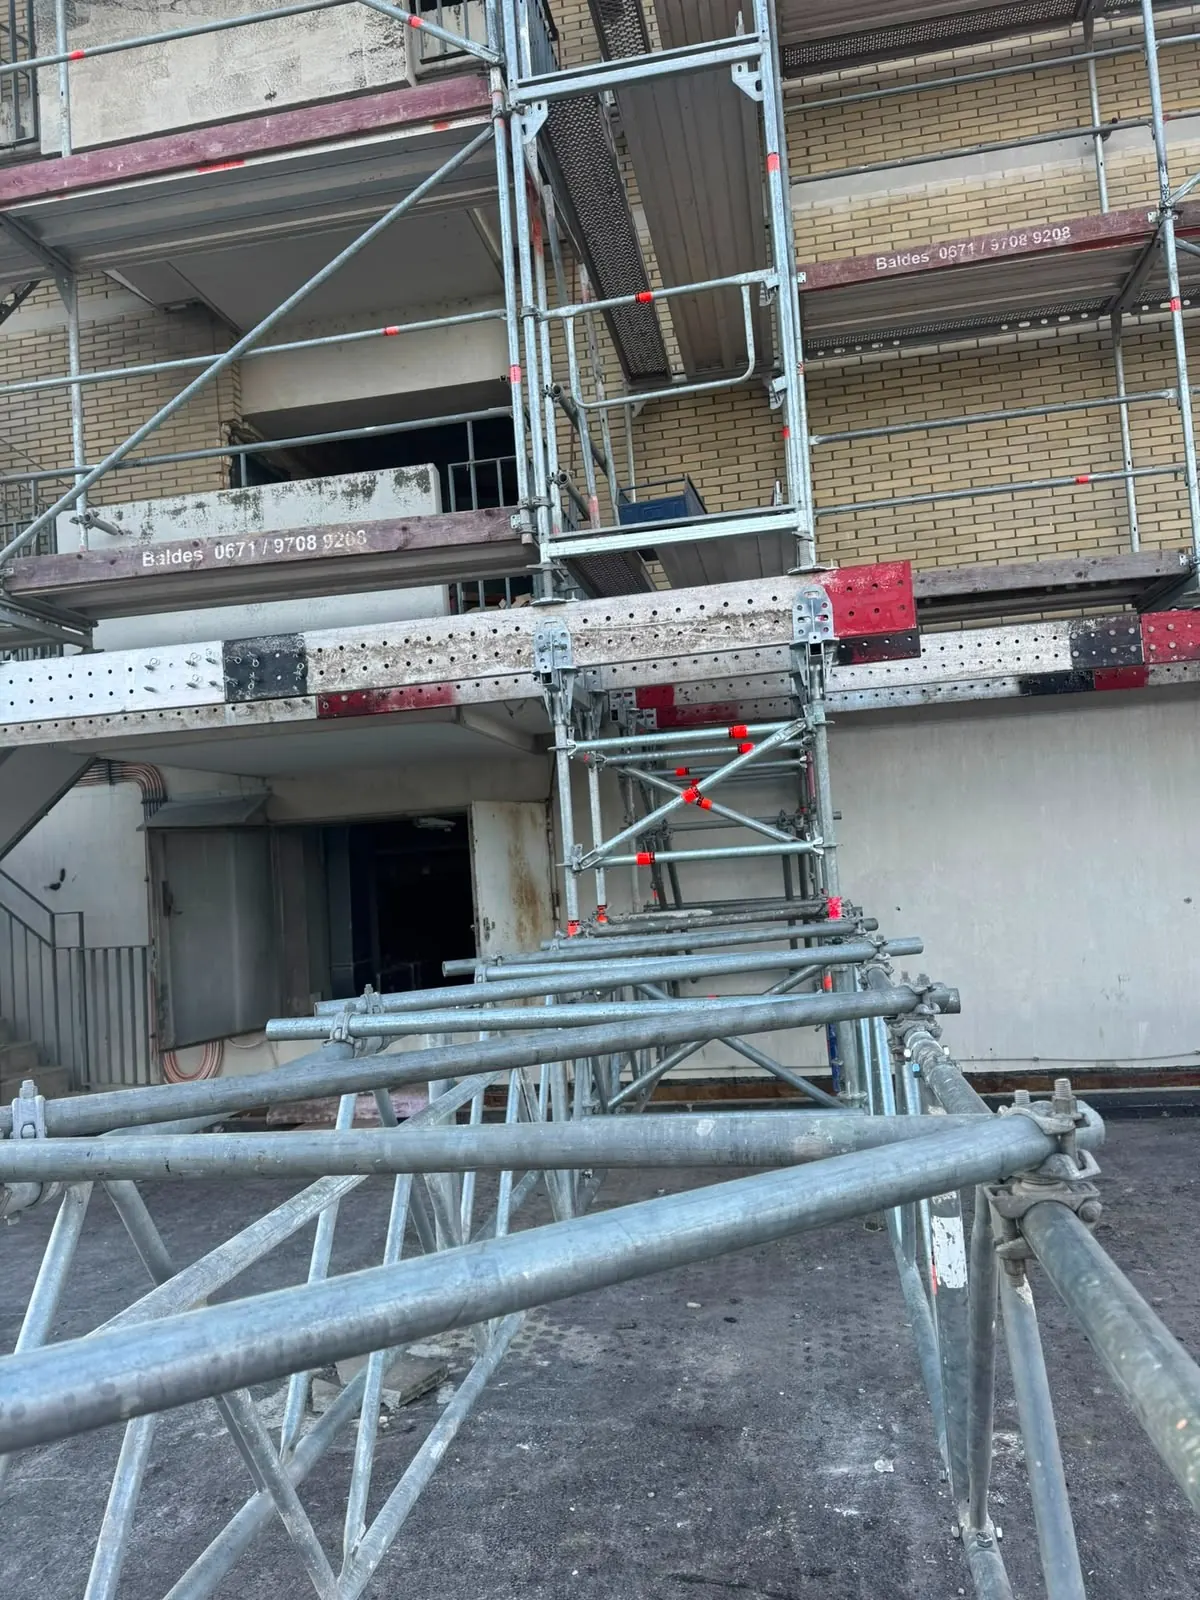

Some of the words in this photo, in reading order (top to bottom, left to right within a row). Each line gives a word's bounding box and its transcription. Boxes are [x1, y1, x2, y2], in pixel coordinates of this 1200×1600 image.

[875, 251, 930, 271] Baldes
[938, 242, 975, 260] 0671
[1032, 226, 1071, 245] 9208
[142, 547, 204, 567] Baldes
[214, 540, 256, 560] 0671
[274, 534, 317, 554] 9708
